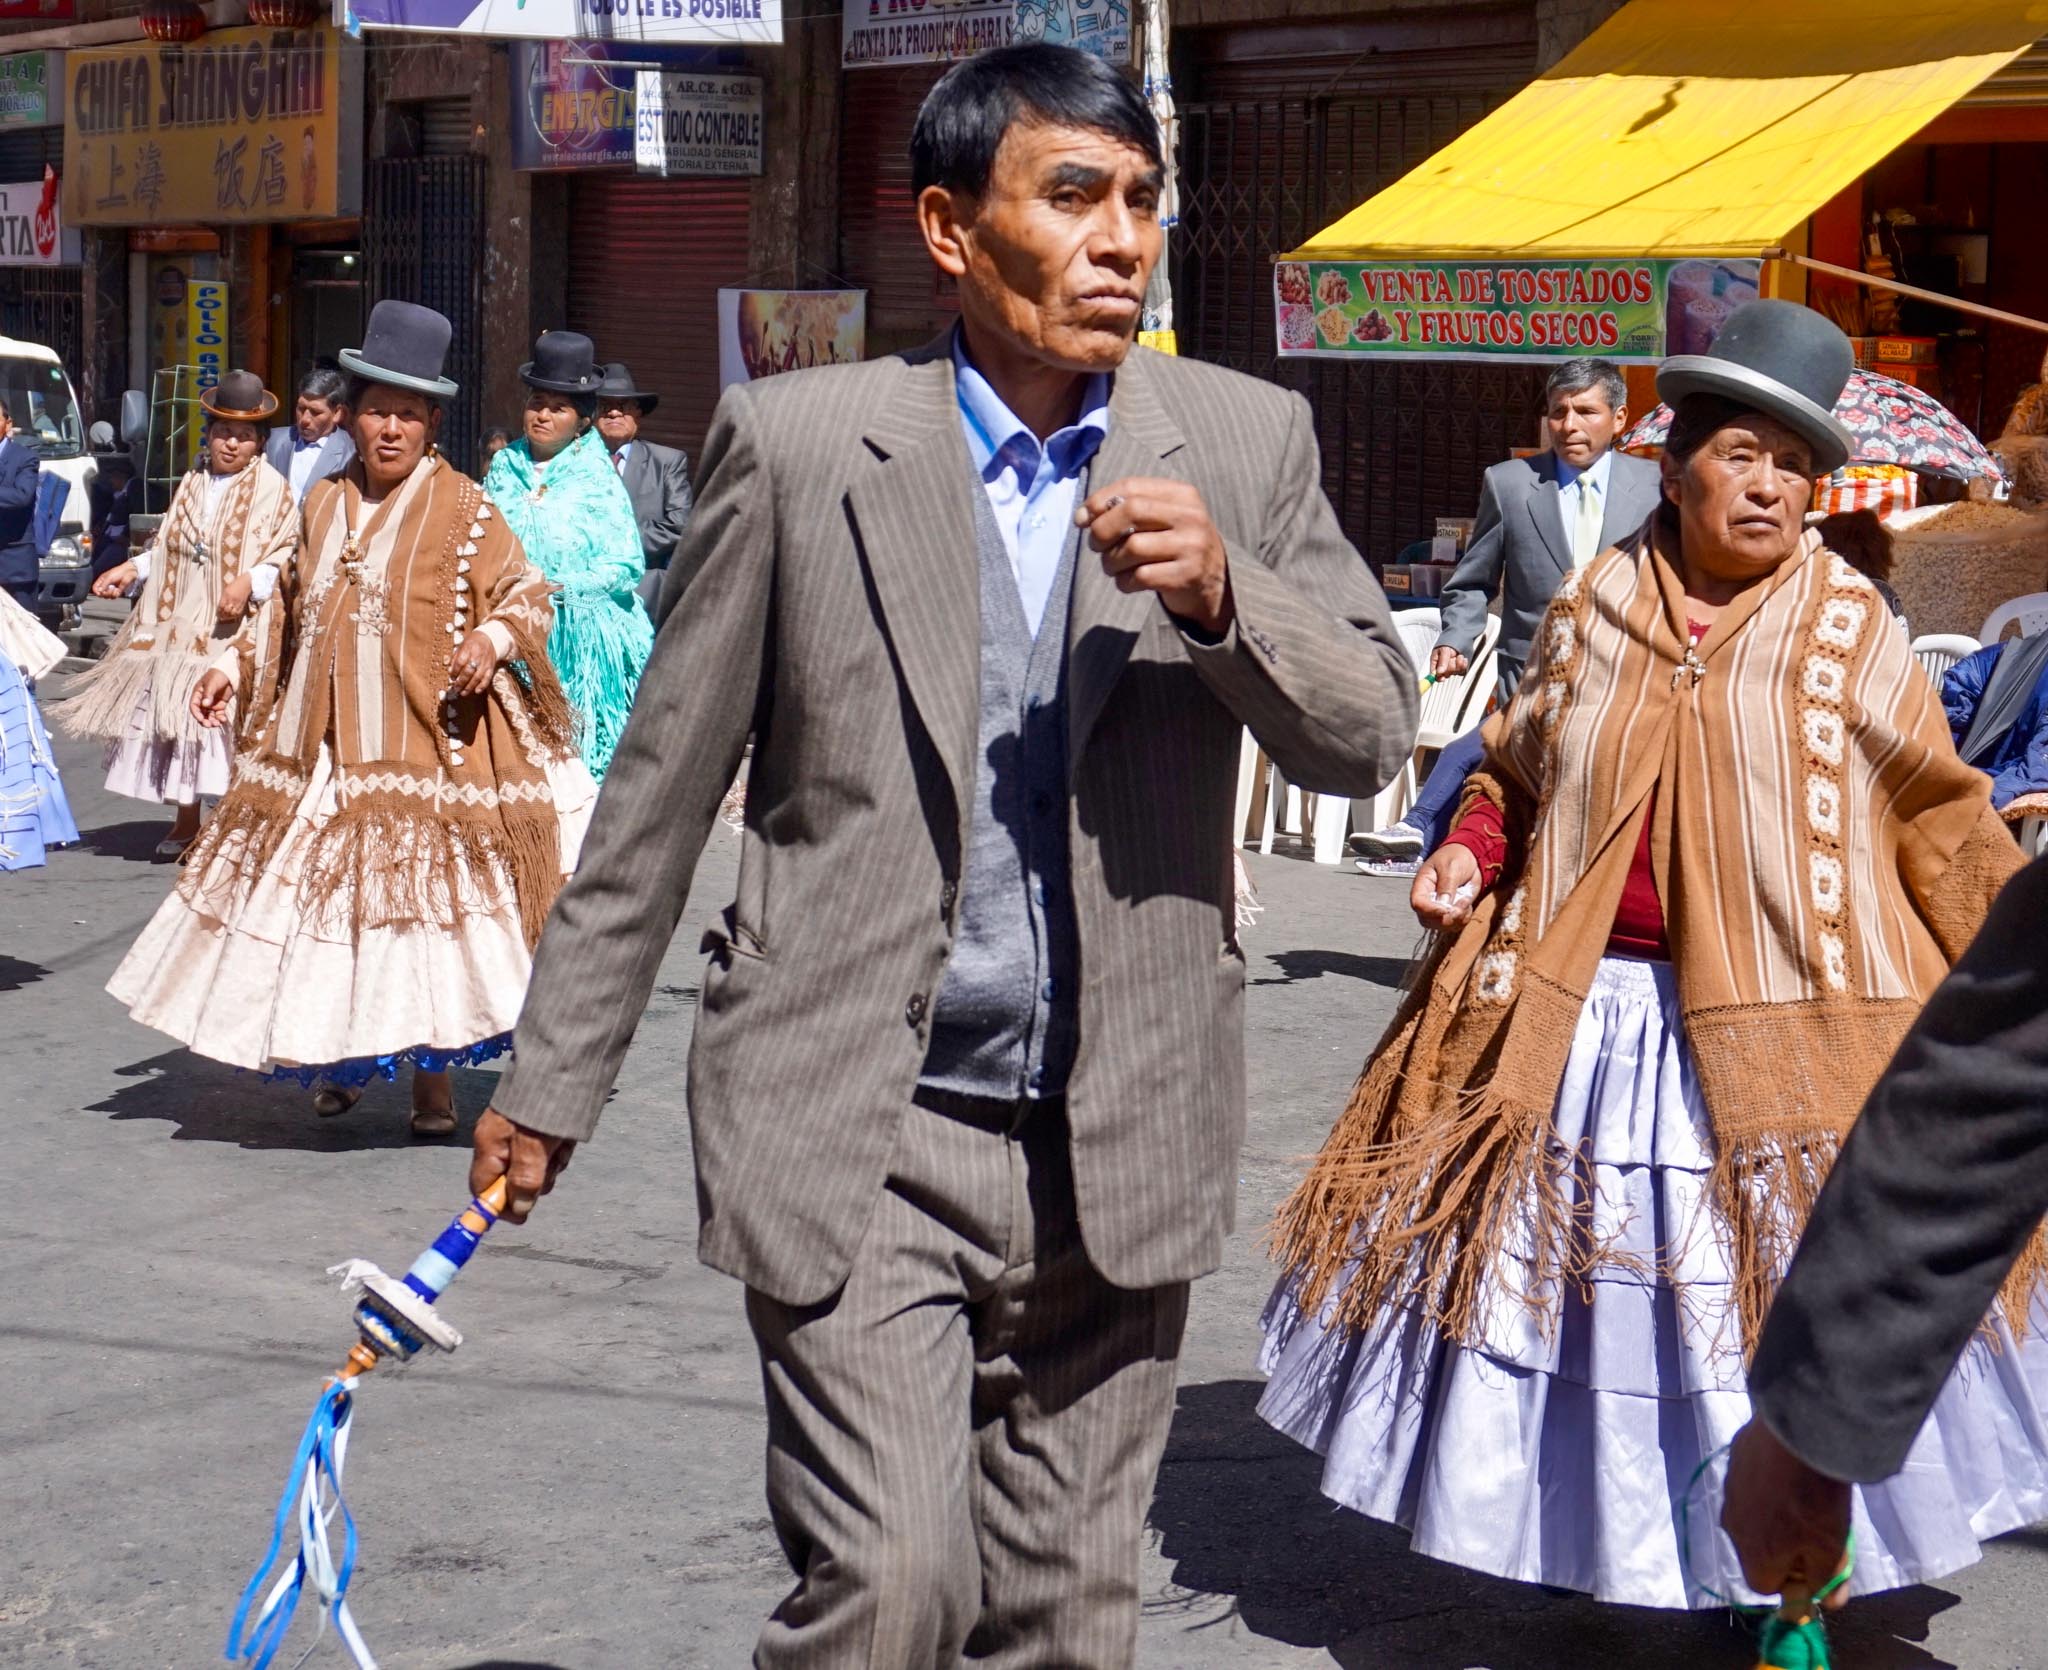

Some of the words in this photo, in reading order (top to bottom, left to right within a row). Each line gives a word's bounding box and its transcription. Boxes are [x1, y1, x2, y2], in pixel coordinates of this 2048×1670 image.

[637, 0, 655, 16] LE
[662, 0, 682, 18] ES
[689, 0, 761, 19] POSIBLE
[853, 27, 886, 59] VENTA
[889, 26, 902, 56] DE
[905, 20, 969, 55] PRODUCTOS
[972, 17, 1001, 48] PARA
[74, 54, 149, 136] CHIFA
[157, 30, 324, 128] SHANGHAI
[638, 109, 693, 145] ESTUDIO
[695, 110, 760, 147] CONTABLE
[639, 146, 711, 158] CONTABILIDAD
[714, 149, 759, 160] GENERAL
[649, 159, 702, 170] AUDITORIA
[704, 161, 750, 171] EXTERNA
[95, 141, 167, 216] 上海
[1360, 269, 1454, 303] VENTA
[1457, 269, 1496, 304] DE
[1498, 268, 1652, 305] TOSTADOS
[195, 287, 222, 345] POLLO
[1393, 310, 1413, 343] Y
[1417, 310, 1525, 346] FRUTOS
[1529, 310, 1619, 347] SECOS
